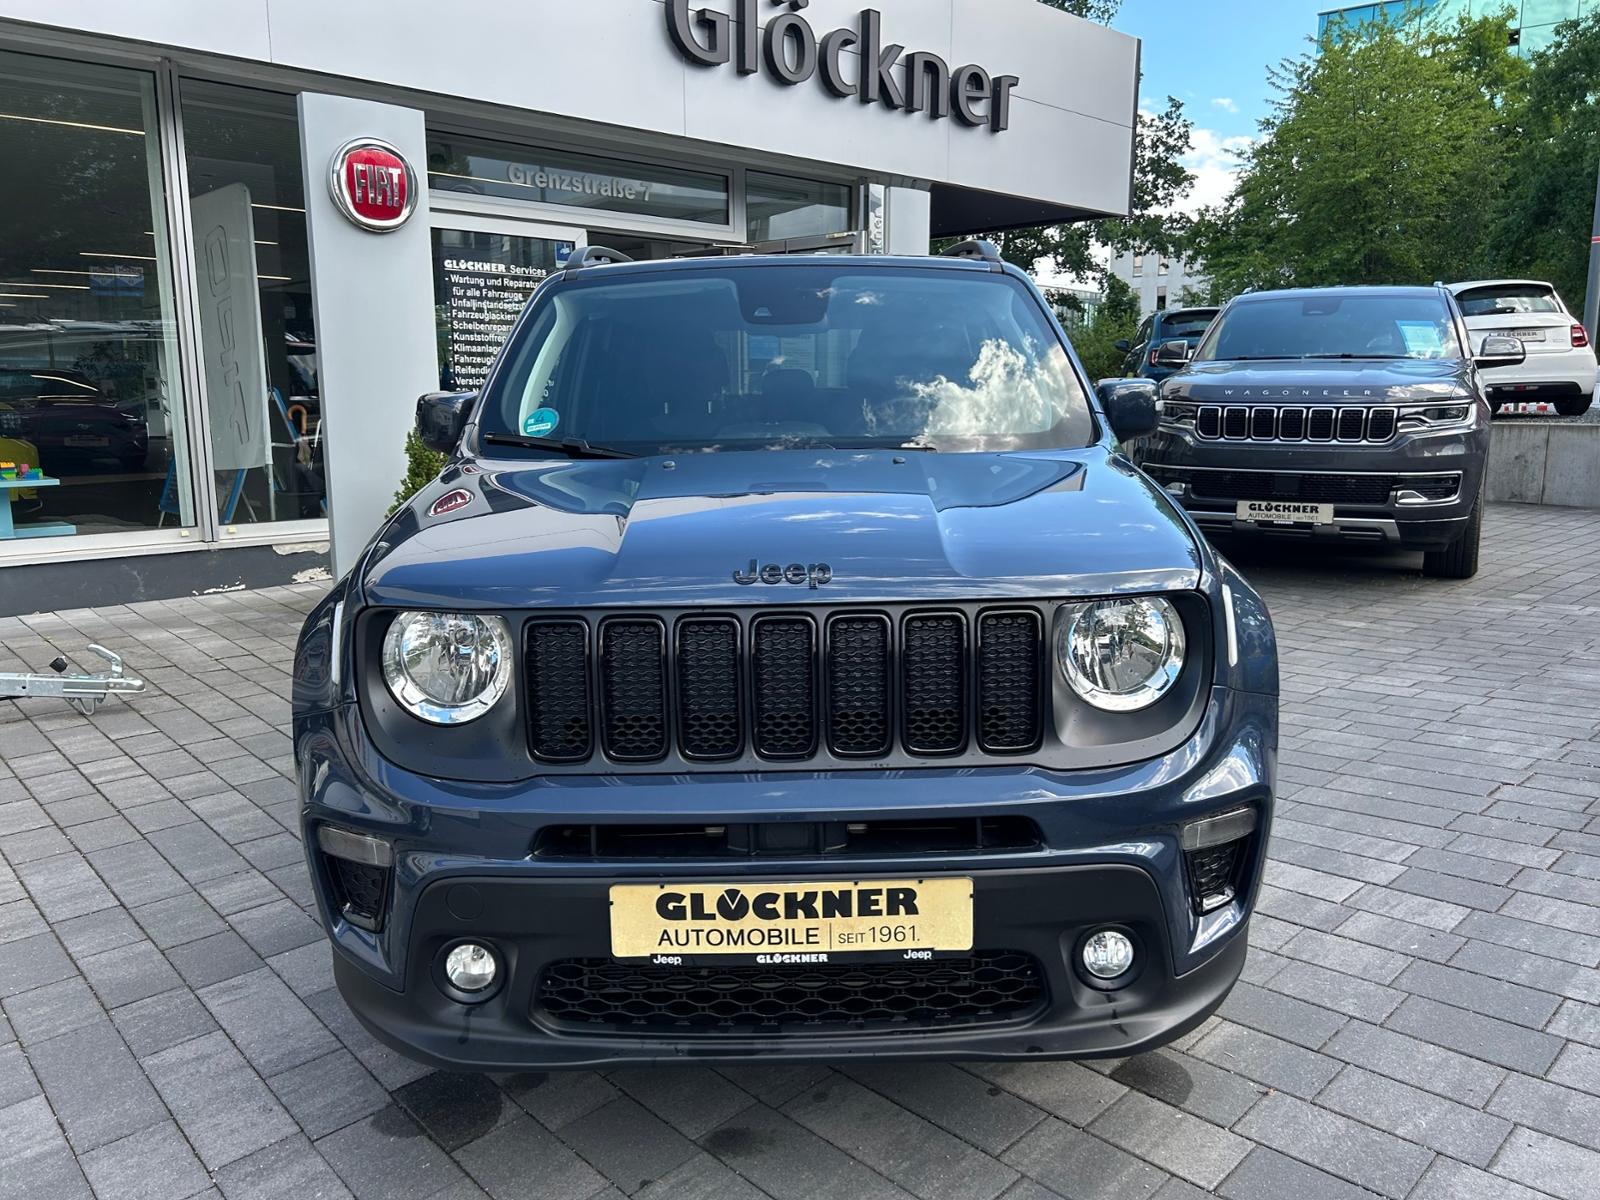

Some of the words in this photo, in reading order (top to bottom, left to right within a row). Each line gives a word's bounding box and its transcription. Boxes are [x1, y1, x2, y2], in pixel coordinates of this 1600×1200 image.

[664, 0, 1020, 132] Glöckner
[353, 163, 401, 207] FIAT
[506, 162, 636, 200] Grenzstraße
[640, 182, 653, 201] 7
[510, 265, 547, 276] Services
[450, 274, 485, 287] Wartung
[486, 279, 501, 287] und
[452, 287, 464, 296] für
[466, 288, 480, 297] alle
[482, 289, 523, 301] Fahrzeuge
[1248, 512, 1291, 520] AUTOMOBILE
[733, 558, 833, 590] Jeep
[657, 927, 820, 947] AUTOMOBILE
[838, 932, 866, 944] SEIT
[653, 954, 682, 965] Jeep
[903, 949, 932, 960] Jeep
